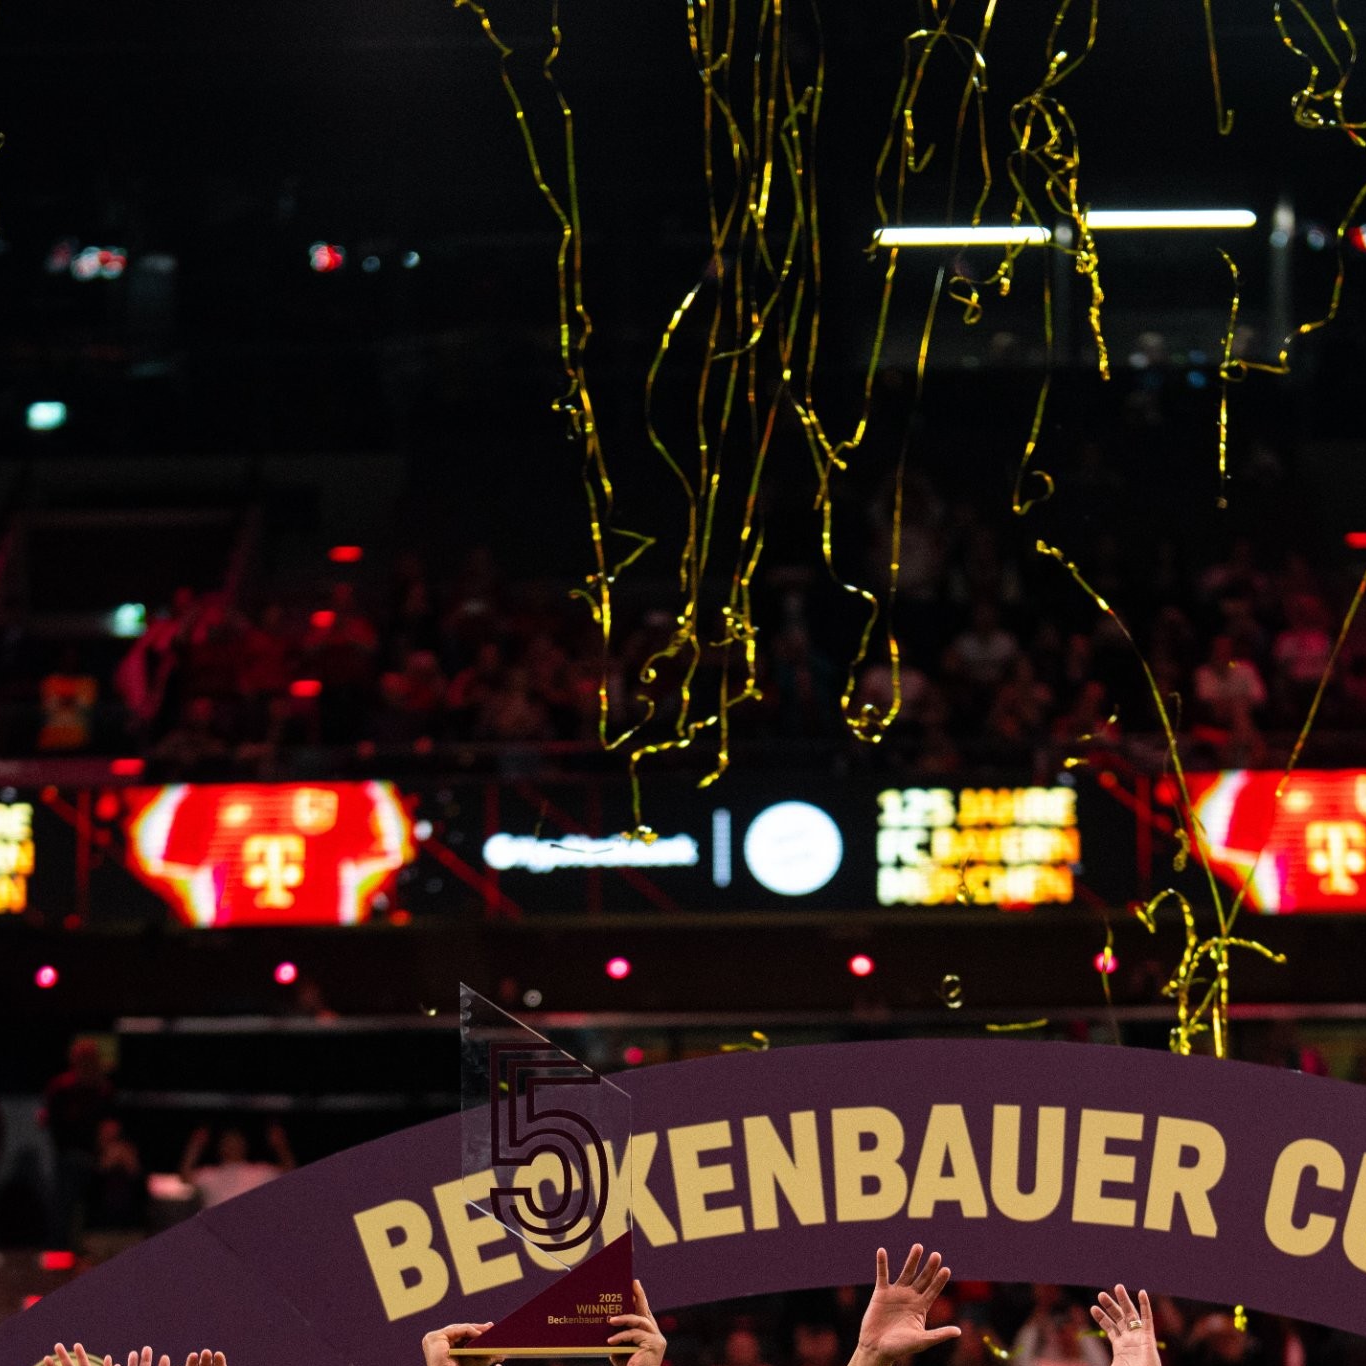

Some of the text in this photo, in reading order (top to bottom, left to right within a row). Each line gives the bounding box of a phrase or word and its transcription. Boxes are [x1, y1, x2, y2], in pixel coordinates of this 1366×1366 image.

[489, 1042, 610, 1252] 5
[352, 1103, 1227, 1322] BECKENBAUER
[598, 1293, 623, 1303] 2025
[576, 1304, 623, 1315] WINNER
[547, 1315, 604, 1325] Beckenbauer
